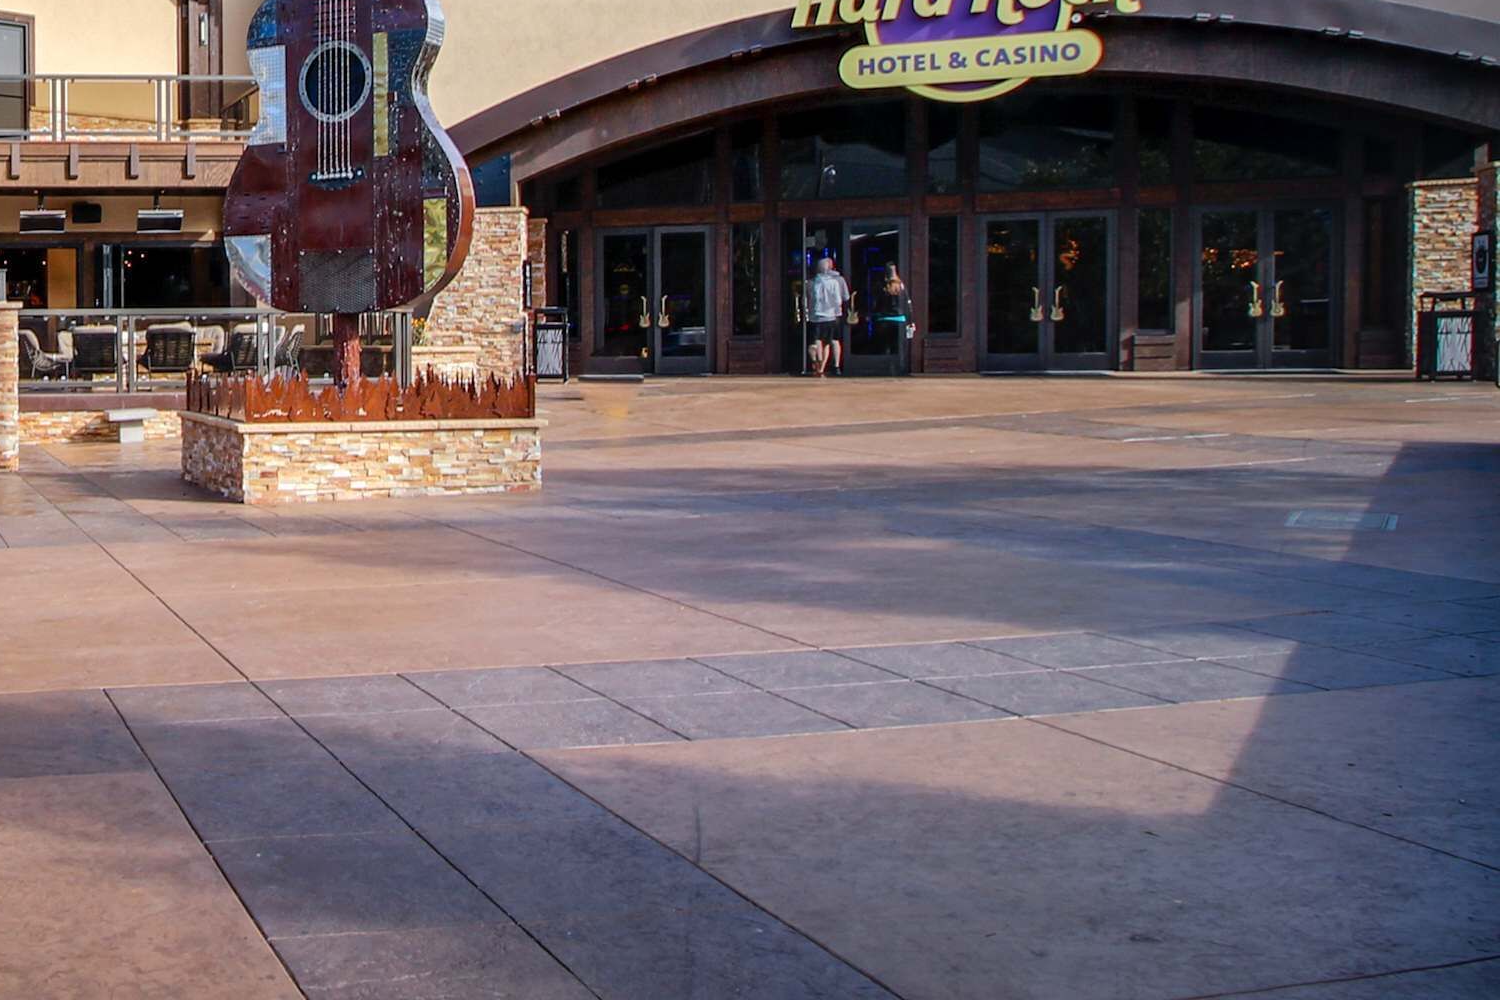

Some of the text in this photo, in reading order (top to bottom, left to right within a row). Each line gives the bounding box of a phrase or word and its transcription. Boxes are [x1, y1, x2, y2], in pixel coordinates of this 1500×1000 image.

[858, 43, 1081, 76] HOTEL & CASINO
